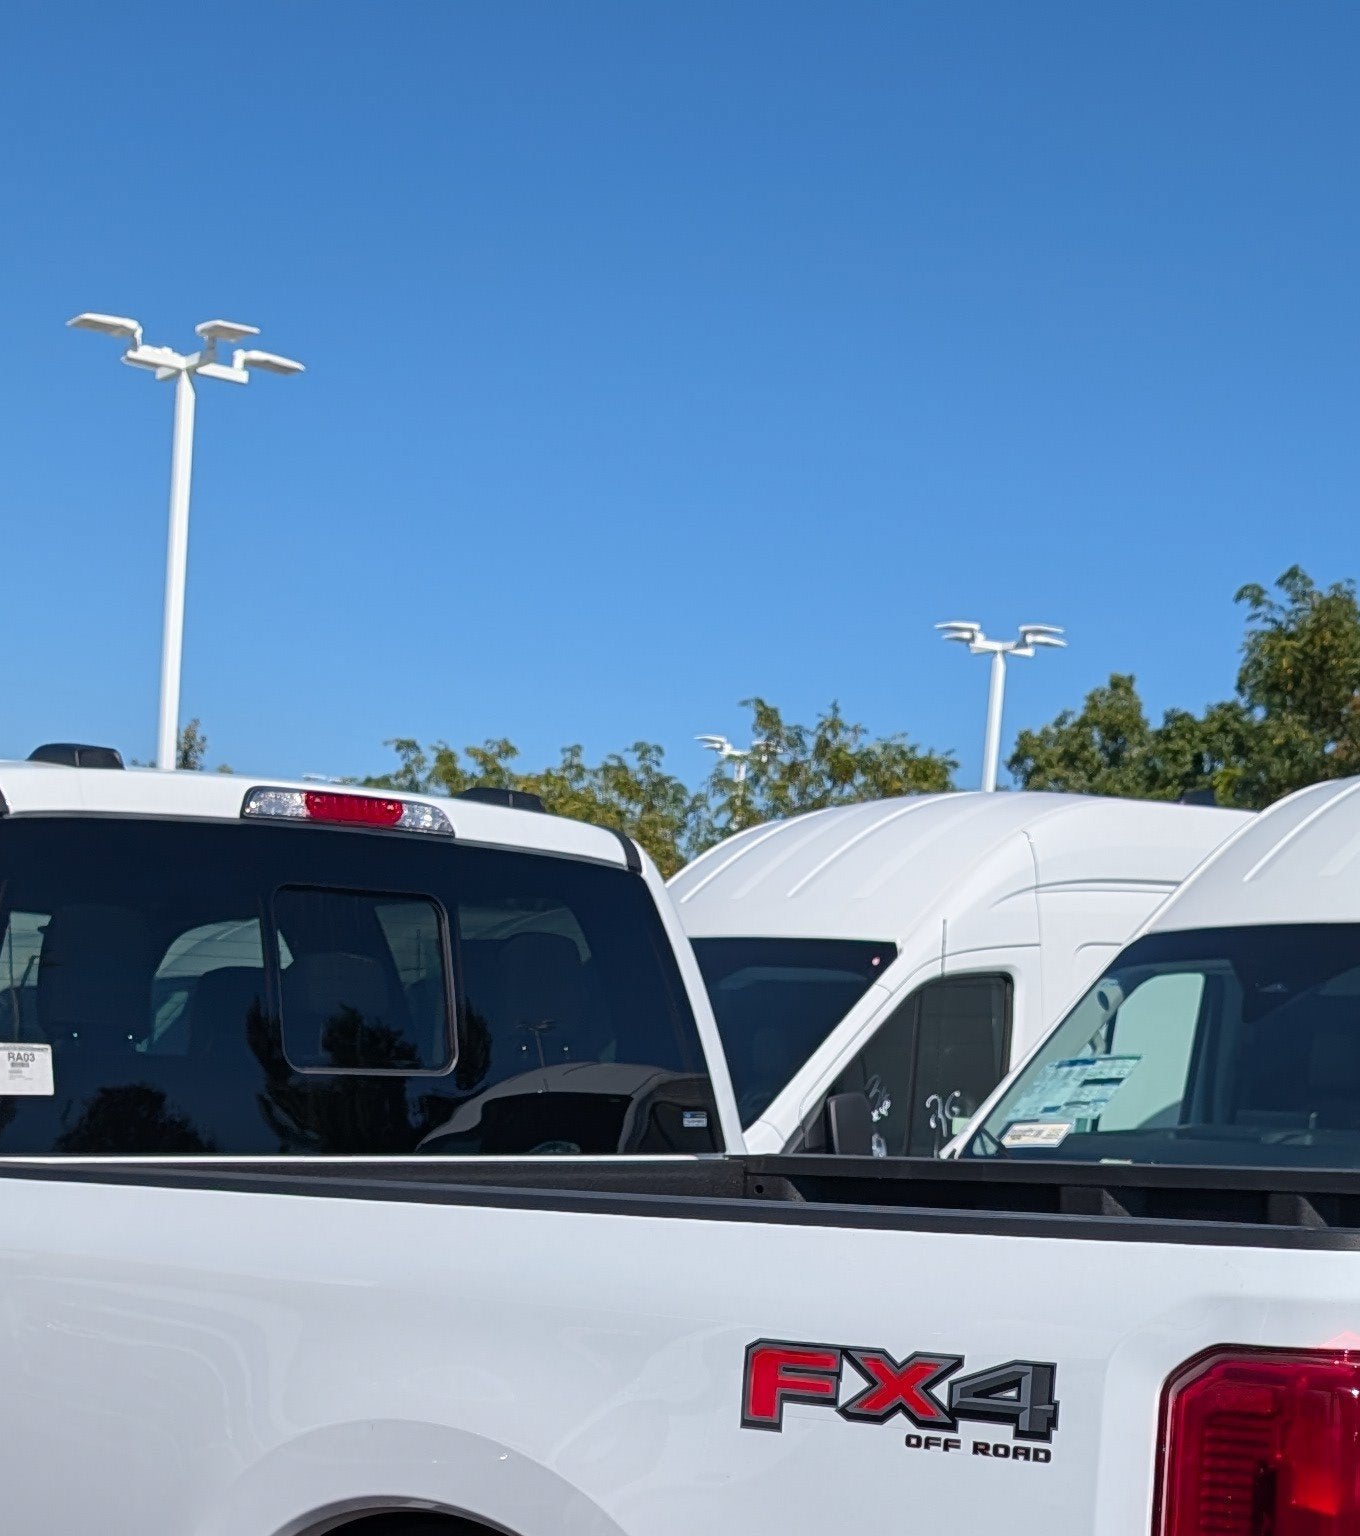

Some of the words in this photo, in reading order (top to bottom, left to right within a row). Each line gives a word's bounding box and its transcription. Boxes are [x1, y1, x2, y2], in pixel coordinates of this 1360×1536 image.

[740, 1338, 1060, 1444] FX4
[904, 1433, 961, 1453] OFF
[972, 1440, 1052, 1464] ROAD
